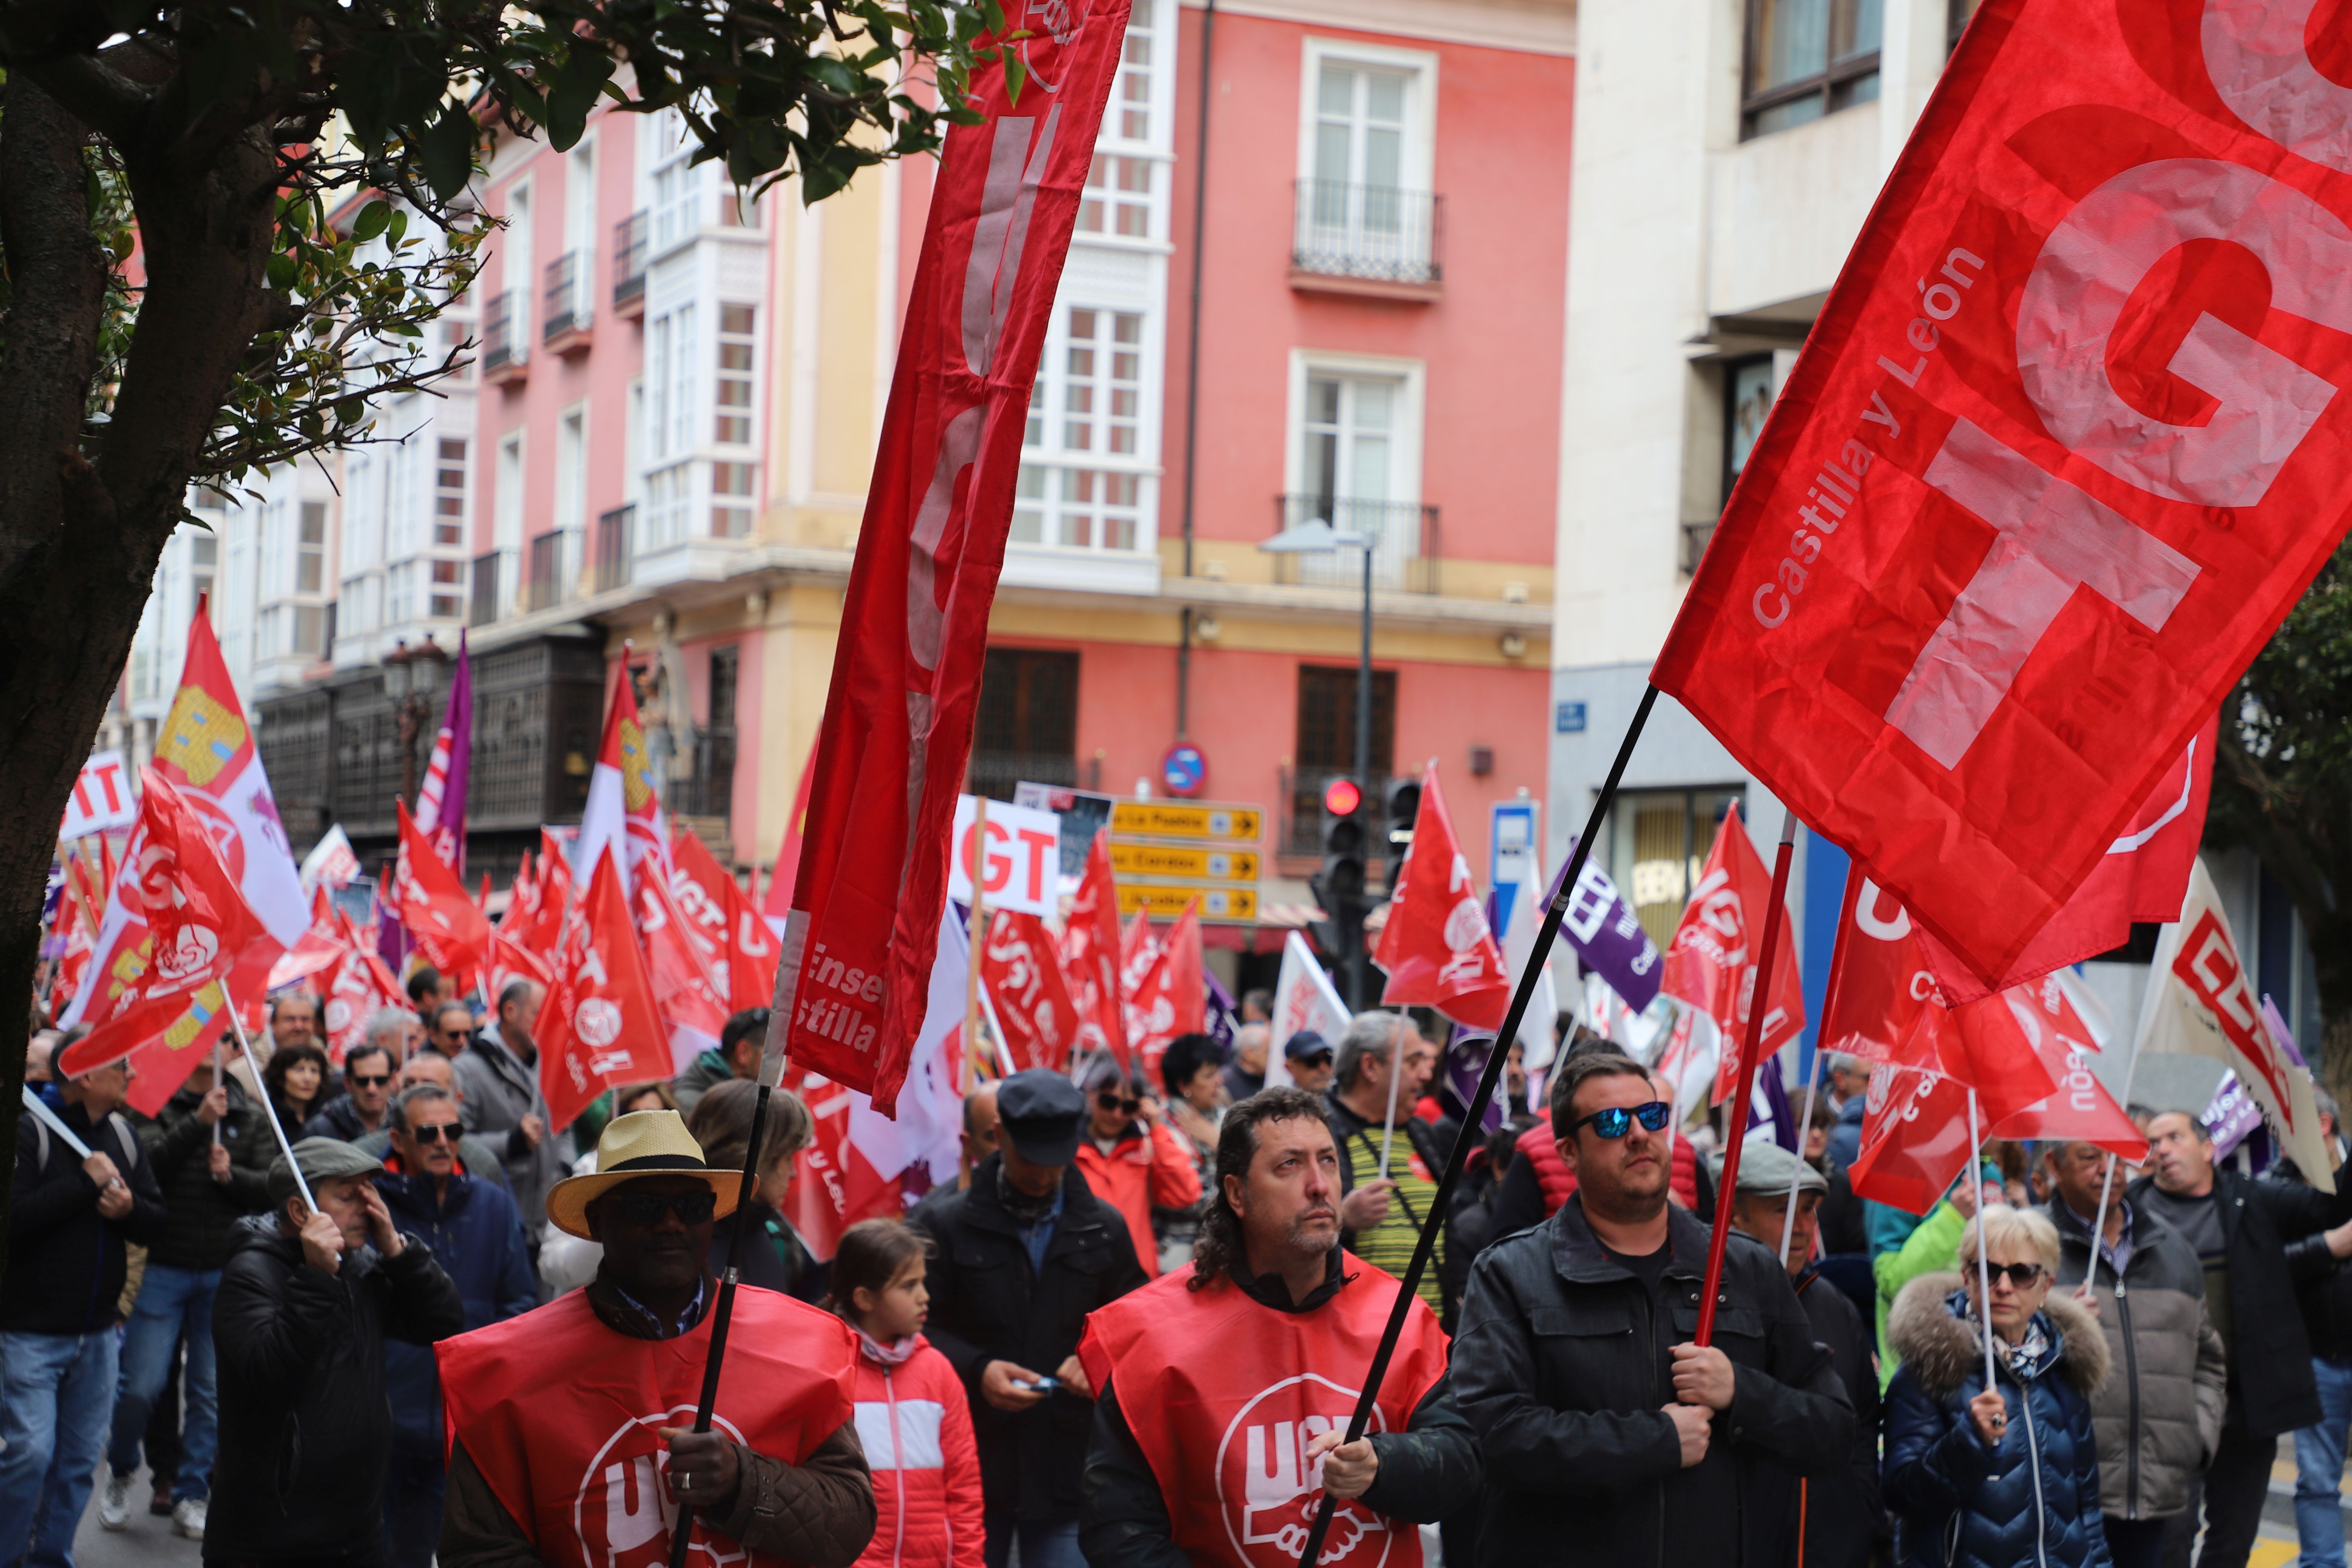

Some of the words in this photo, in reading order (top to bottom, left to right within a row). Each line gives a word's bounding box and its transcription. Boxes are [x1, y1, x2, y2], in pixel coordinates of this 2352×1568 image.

[1876, 247, 1985, 389] León
[1860, 390, 1900, 439] y
[1752, 438, 1873, 629] Castilla
[948, 820, 1055, 903] GT
